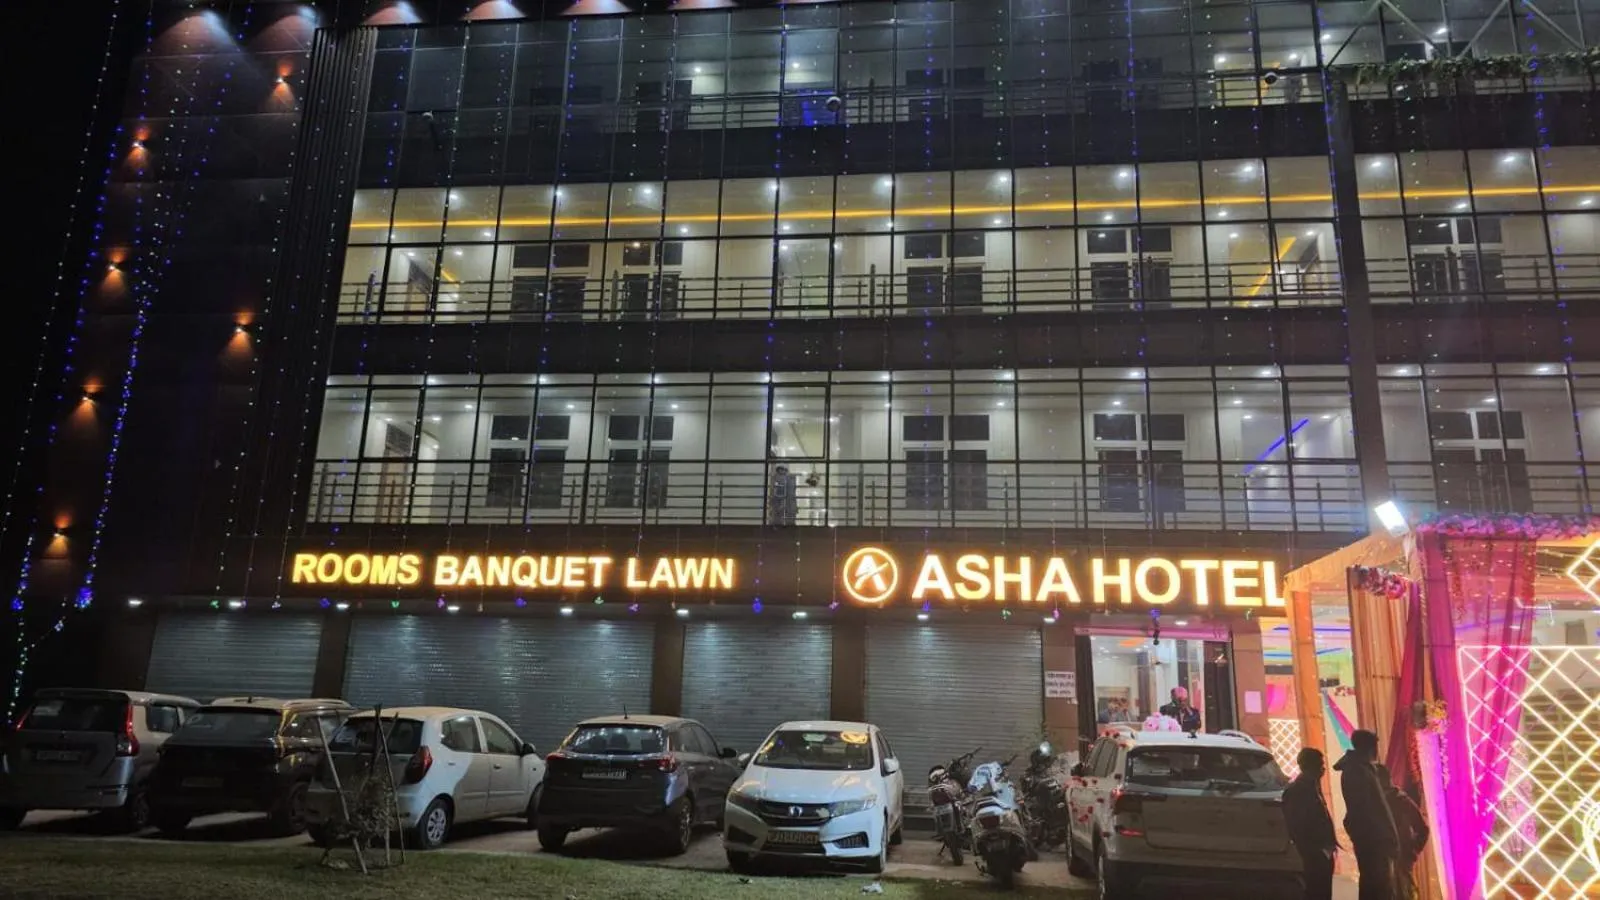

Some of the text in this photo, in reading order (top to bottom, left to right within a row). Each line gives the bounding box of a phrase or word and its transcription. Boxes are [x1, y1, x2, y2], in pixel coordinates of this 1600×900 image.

[293, 553, 734, 589] ROOMS BANQUET LAWN
[912, 554, 1286, 606] ASHA HOTEL
